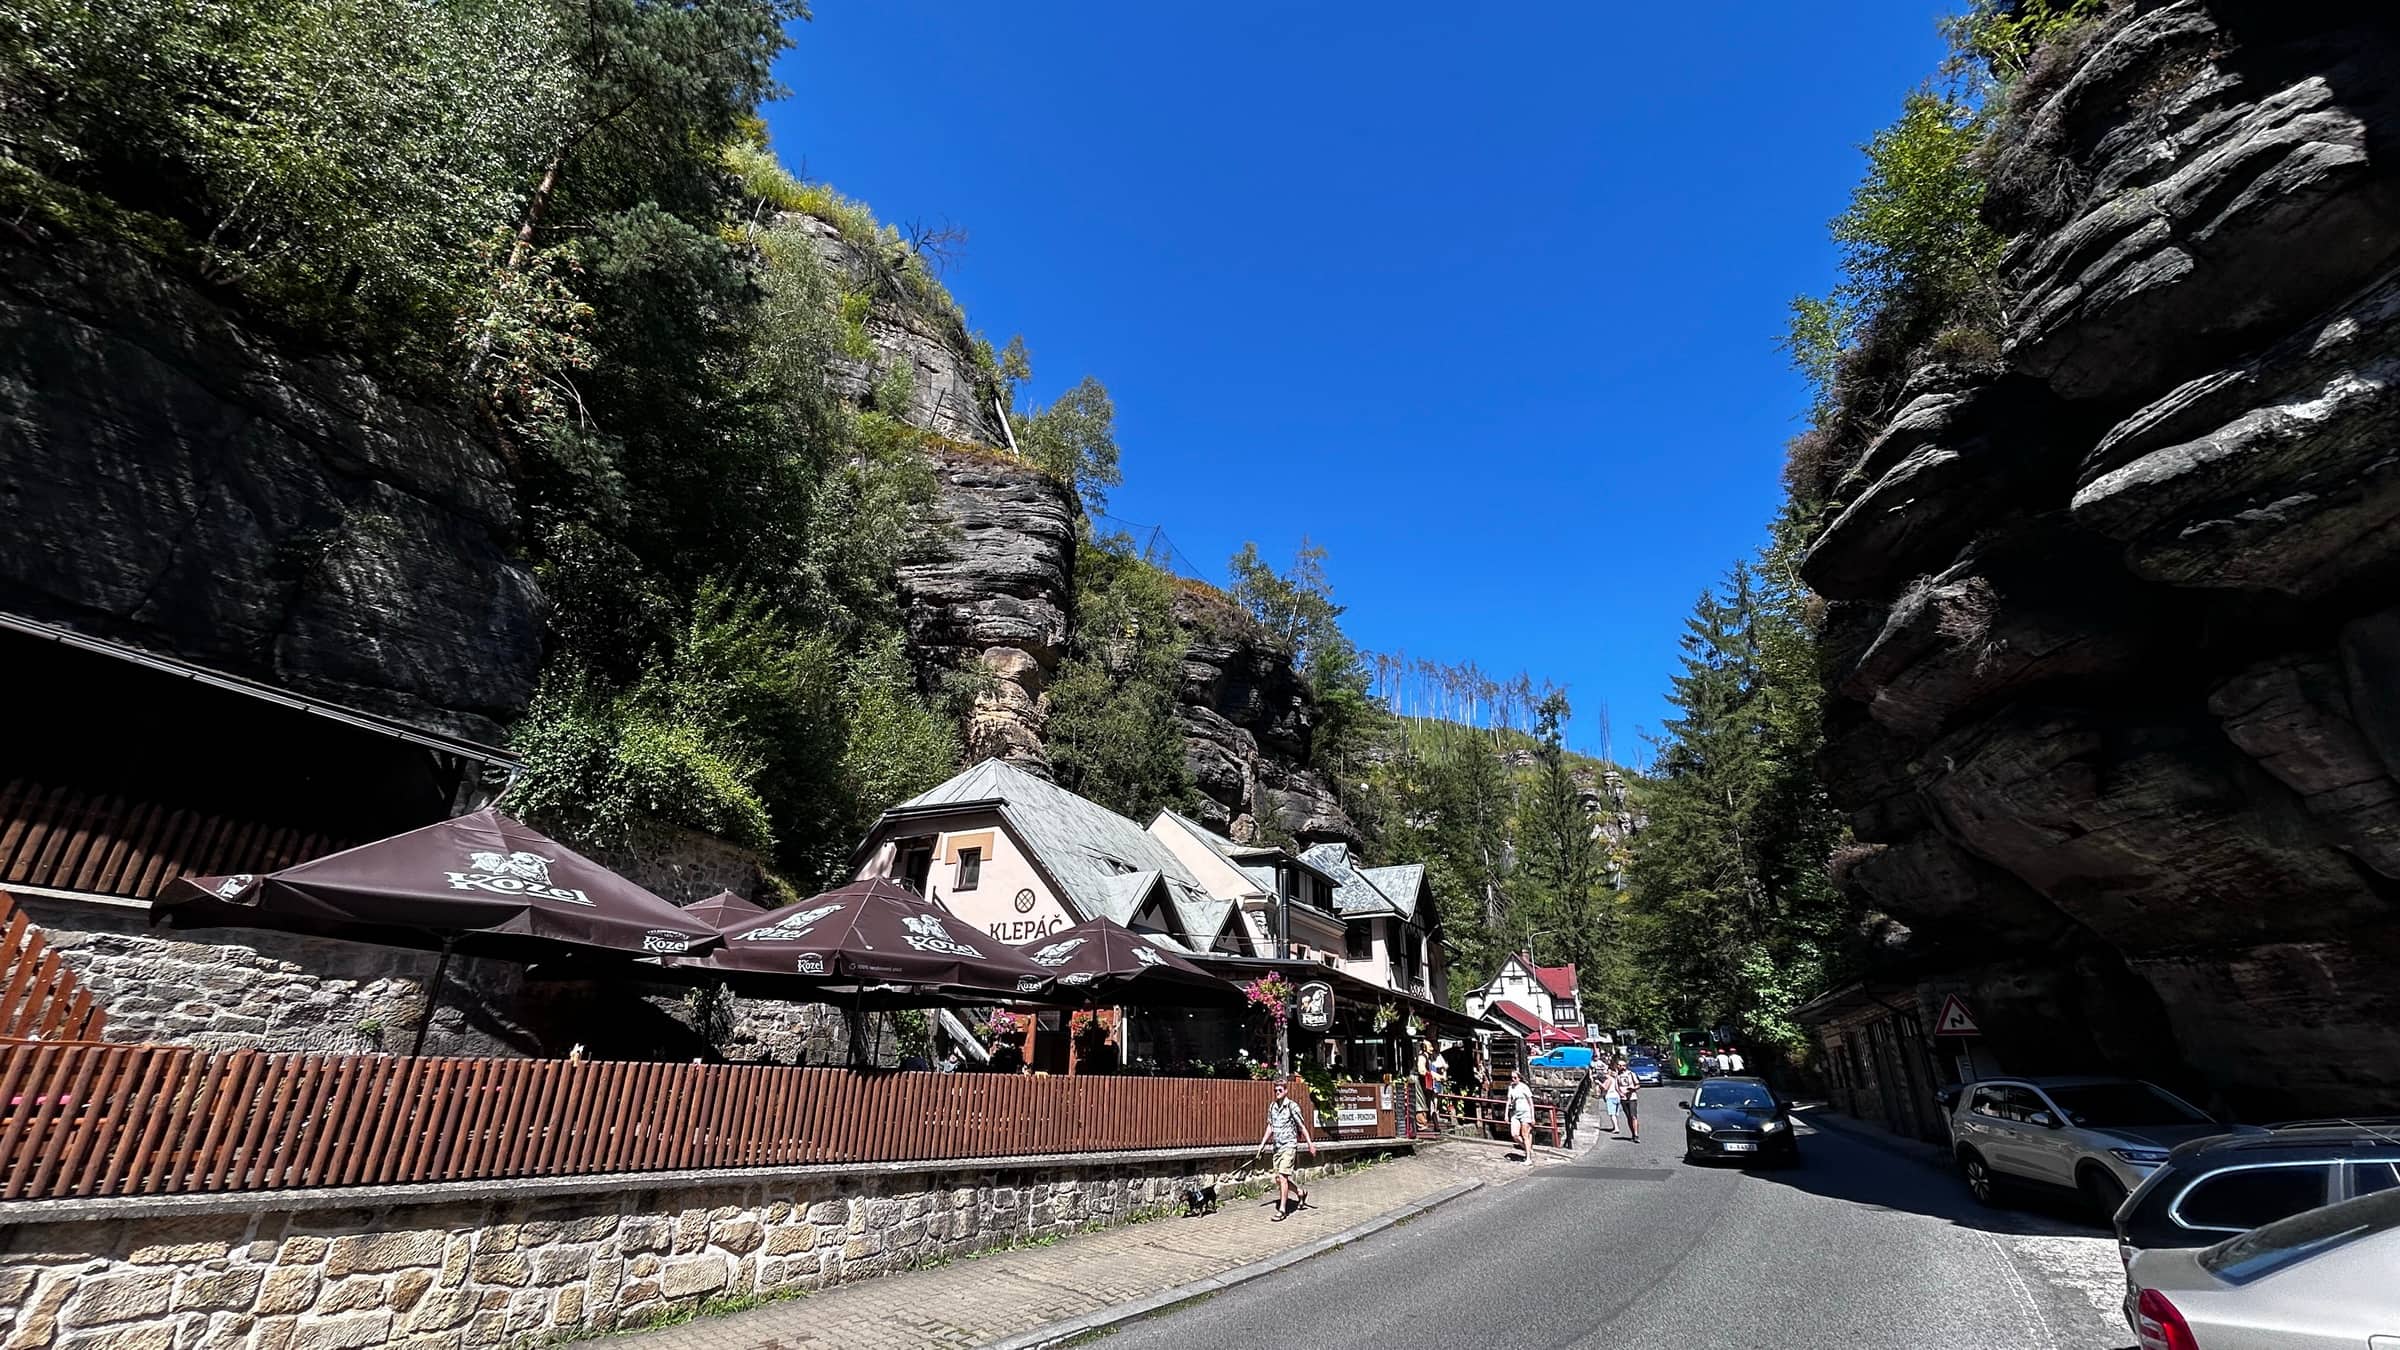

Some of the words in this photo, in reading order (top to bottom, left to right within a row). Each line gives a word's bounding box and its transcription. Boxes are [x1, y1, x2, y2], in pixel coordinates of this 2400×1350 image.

[443, 871, 596, 907] Kozel
[990, 914, 1062, 941] KLEPÁČ
[643, 936, 689, 953] Kozel
[901, 935, 986, 959] Kozel
[798, 959, 824, 973] Kozel
